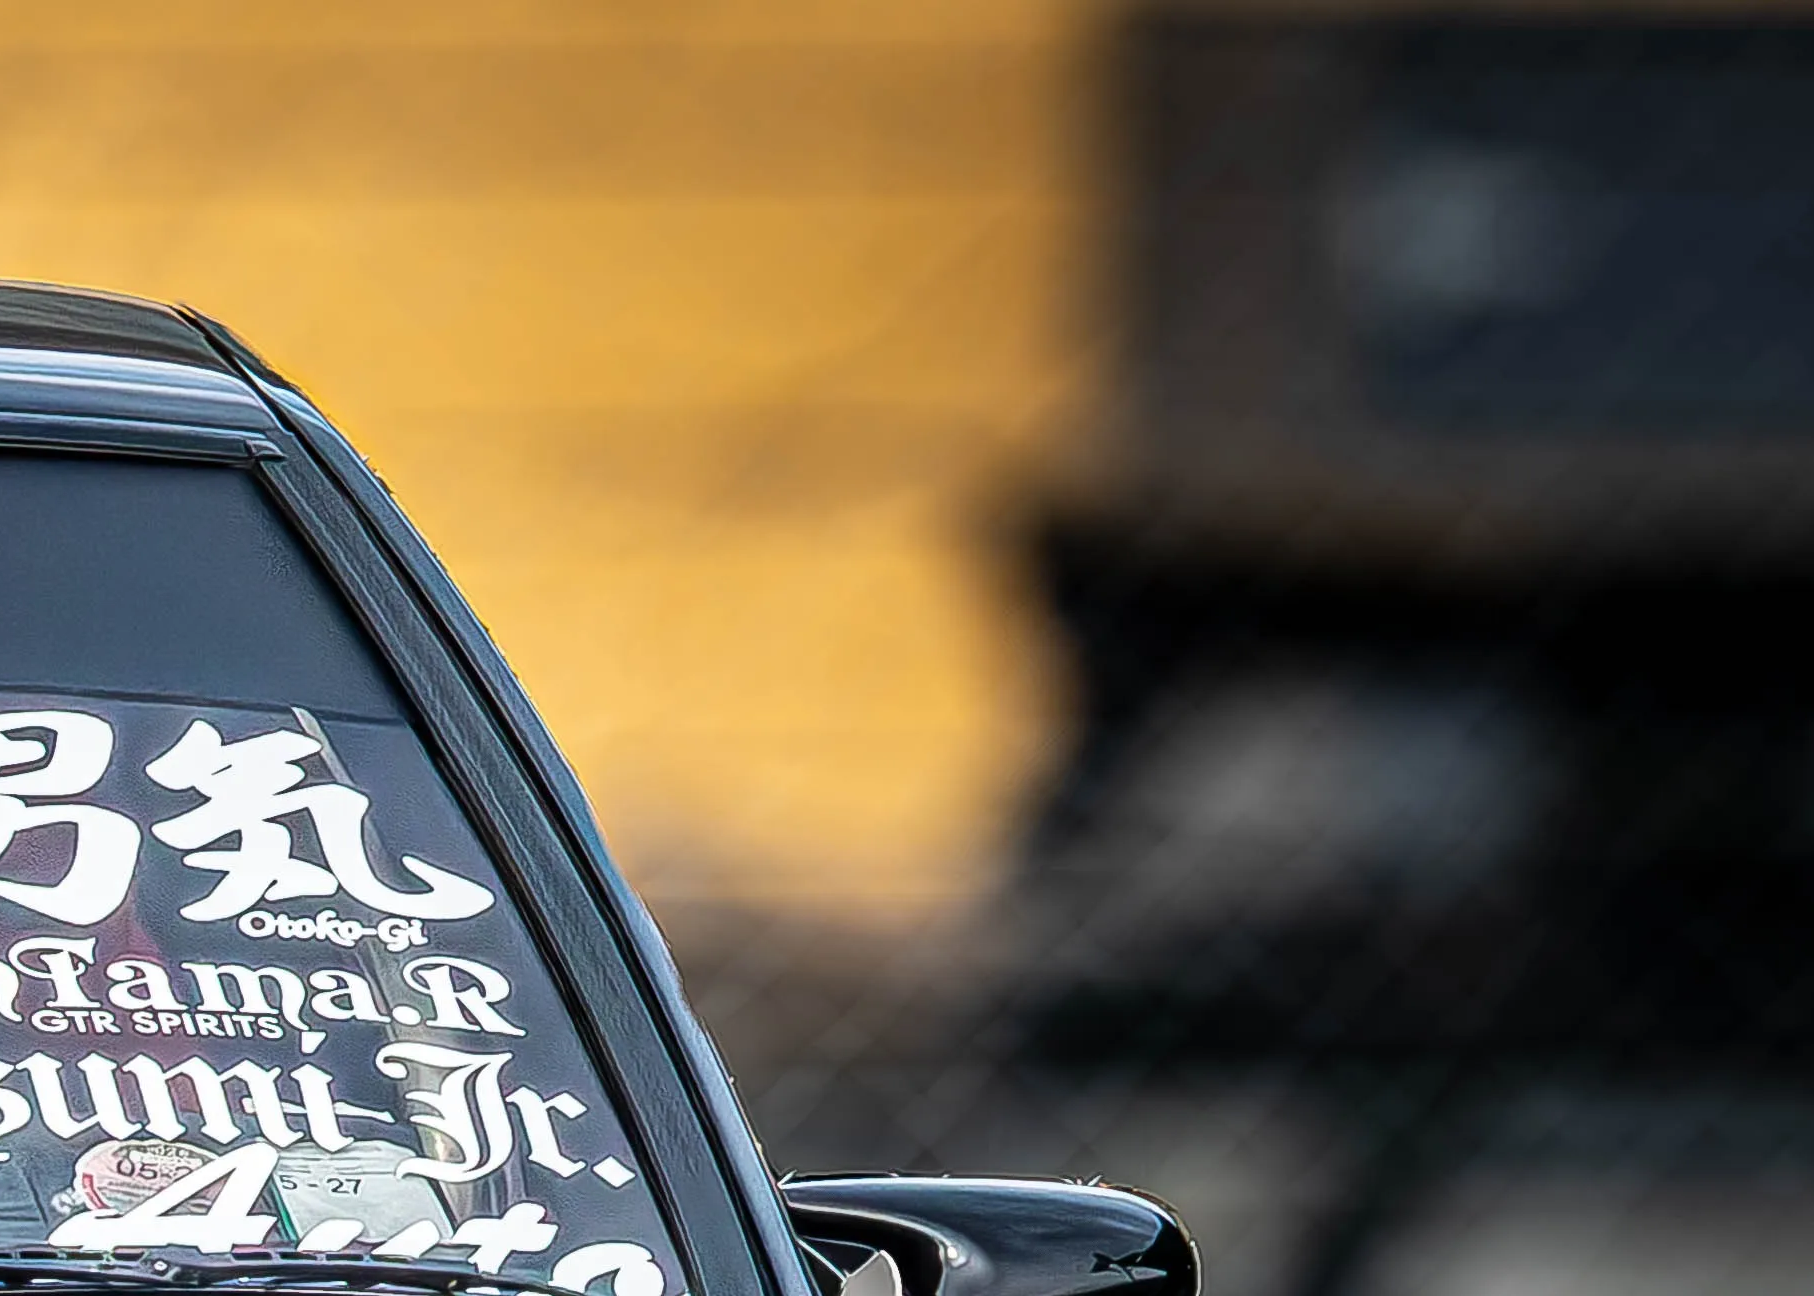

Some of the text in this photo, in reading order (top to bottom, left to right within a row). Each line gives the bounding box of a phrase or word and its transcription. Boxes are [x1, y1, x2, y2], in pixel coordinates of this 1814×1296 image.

[30, 1008, 286, 1041] GTR SPIRITS
[376, 1041, 637, 1190] Jr.
